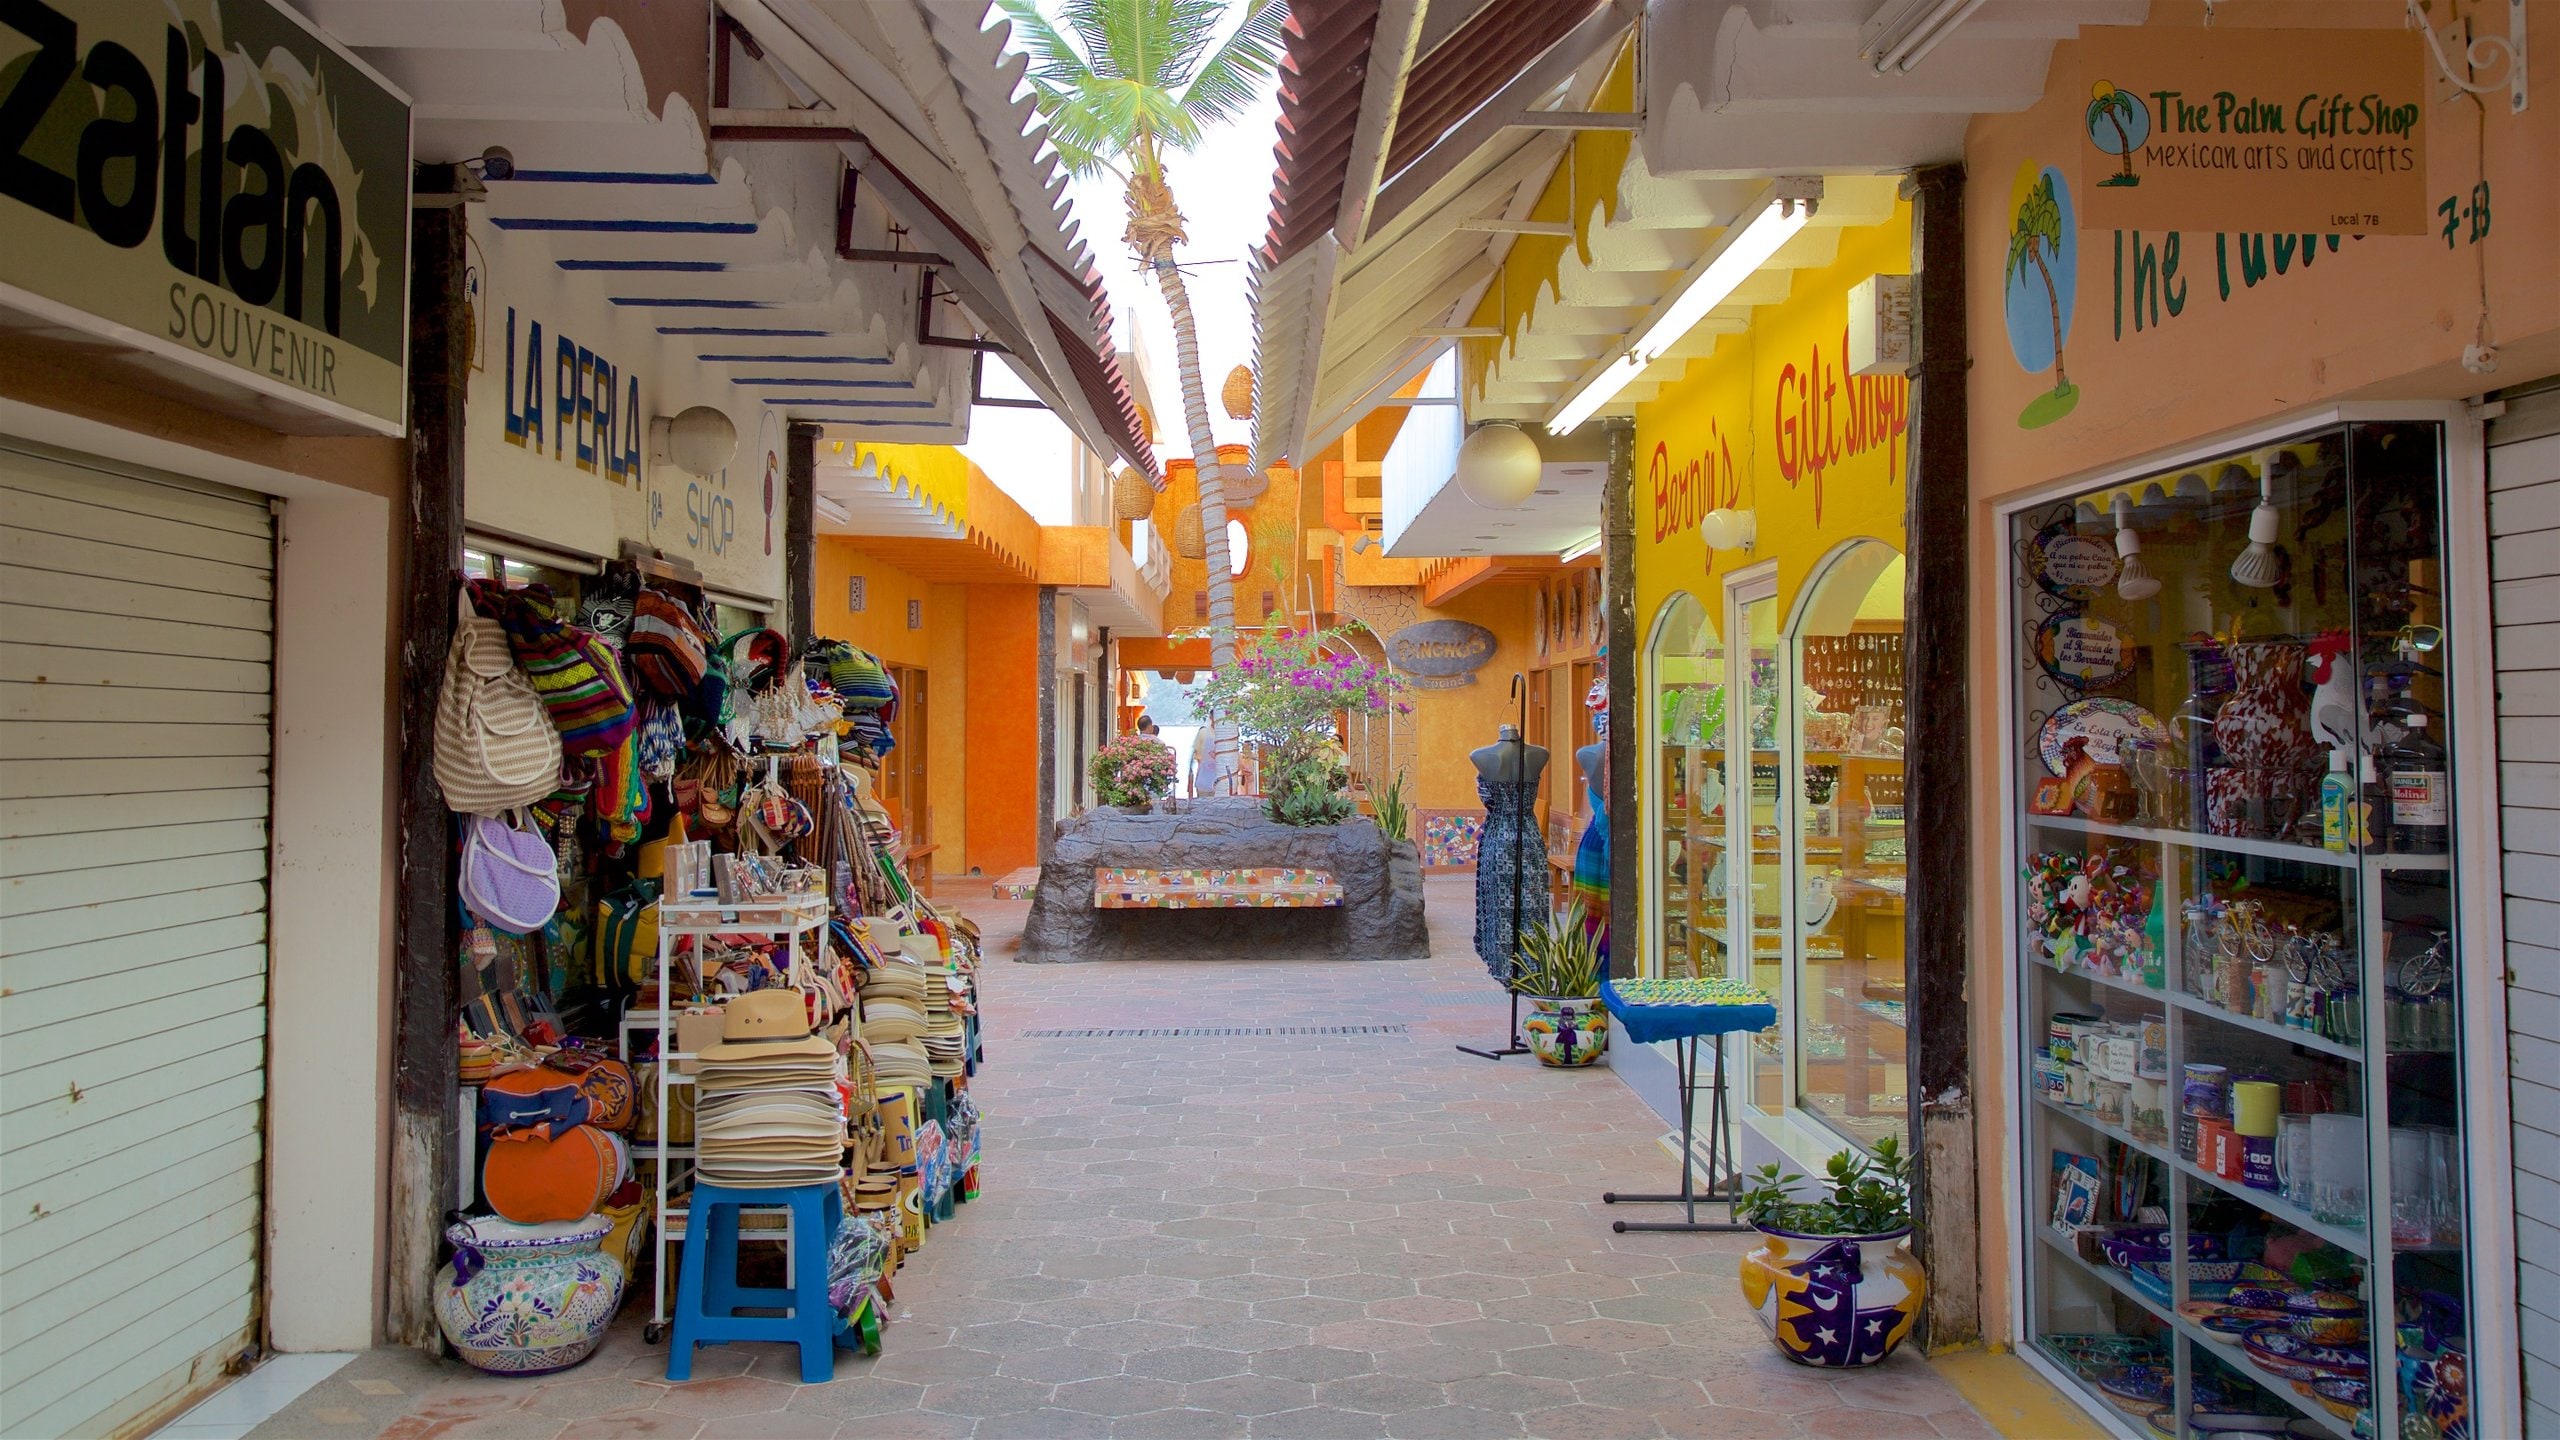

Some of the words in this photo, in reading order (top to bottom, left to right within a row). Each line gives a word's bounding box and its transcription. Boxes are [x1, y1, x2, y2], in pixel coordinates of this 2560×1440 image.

[2149, 90, 2212, 134] The
[2213, 91, 2287, 134] Palm
[2295, 93, 2354, 140] Gift
[2356, 94, 2419, 140] Shop
[2145, 142, 2239, 169] Mexican
[2244, 143, 2288, 169] arts
[2297, 143, 2335, 170] and
[2339, 144, 2414, 174] crafts
[2331, 212, 2359, 226] Local
[2363, 214, 2380, 226] 7B
[168, 282, 337, 397] SOUVENIR
[504, 306, 543, 455] LA
[555, 334, 642, 491] PERLA
[1775, 343, 1842, 530] Gift
[687, 482, 734, 560] SHOP
[2052, 536, 2107, 553] Bienvenidos
[2069, 553, 2090, 562] pobre
[2091, 554, 2112, 562] Casa
[2052, 562, 2067, 570] que
[2087, 562, 2109, 571] pobre
[2065, 626, 2113, 642] Bienvenidos
[2063, 641, 2072, 650] al
[2103, 644, 2113, 654] de
[2059, 650, 2072, 662] los
[2073, 651, 2115, 667] Borrachos
[2073, 720, 2086, 733] En
[2088, 724, 2111, 737] Esta
